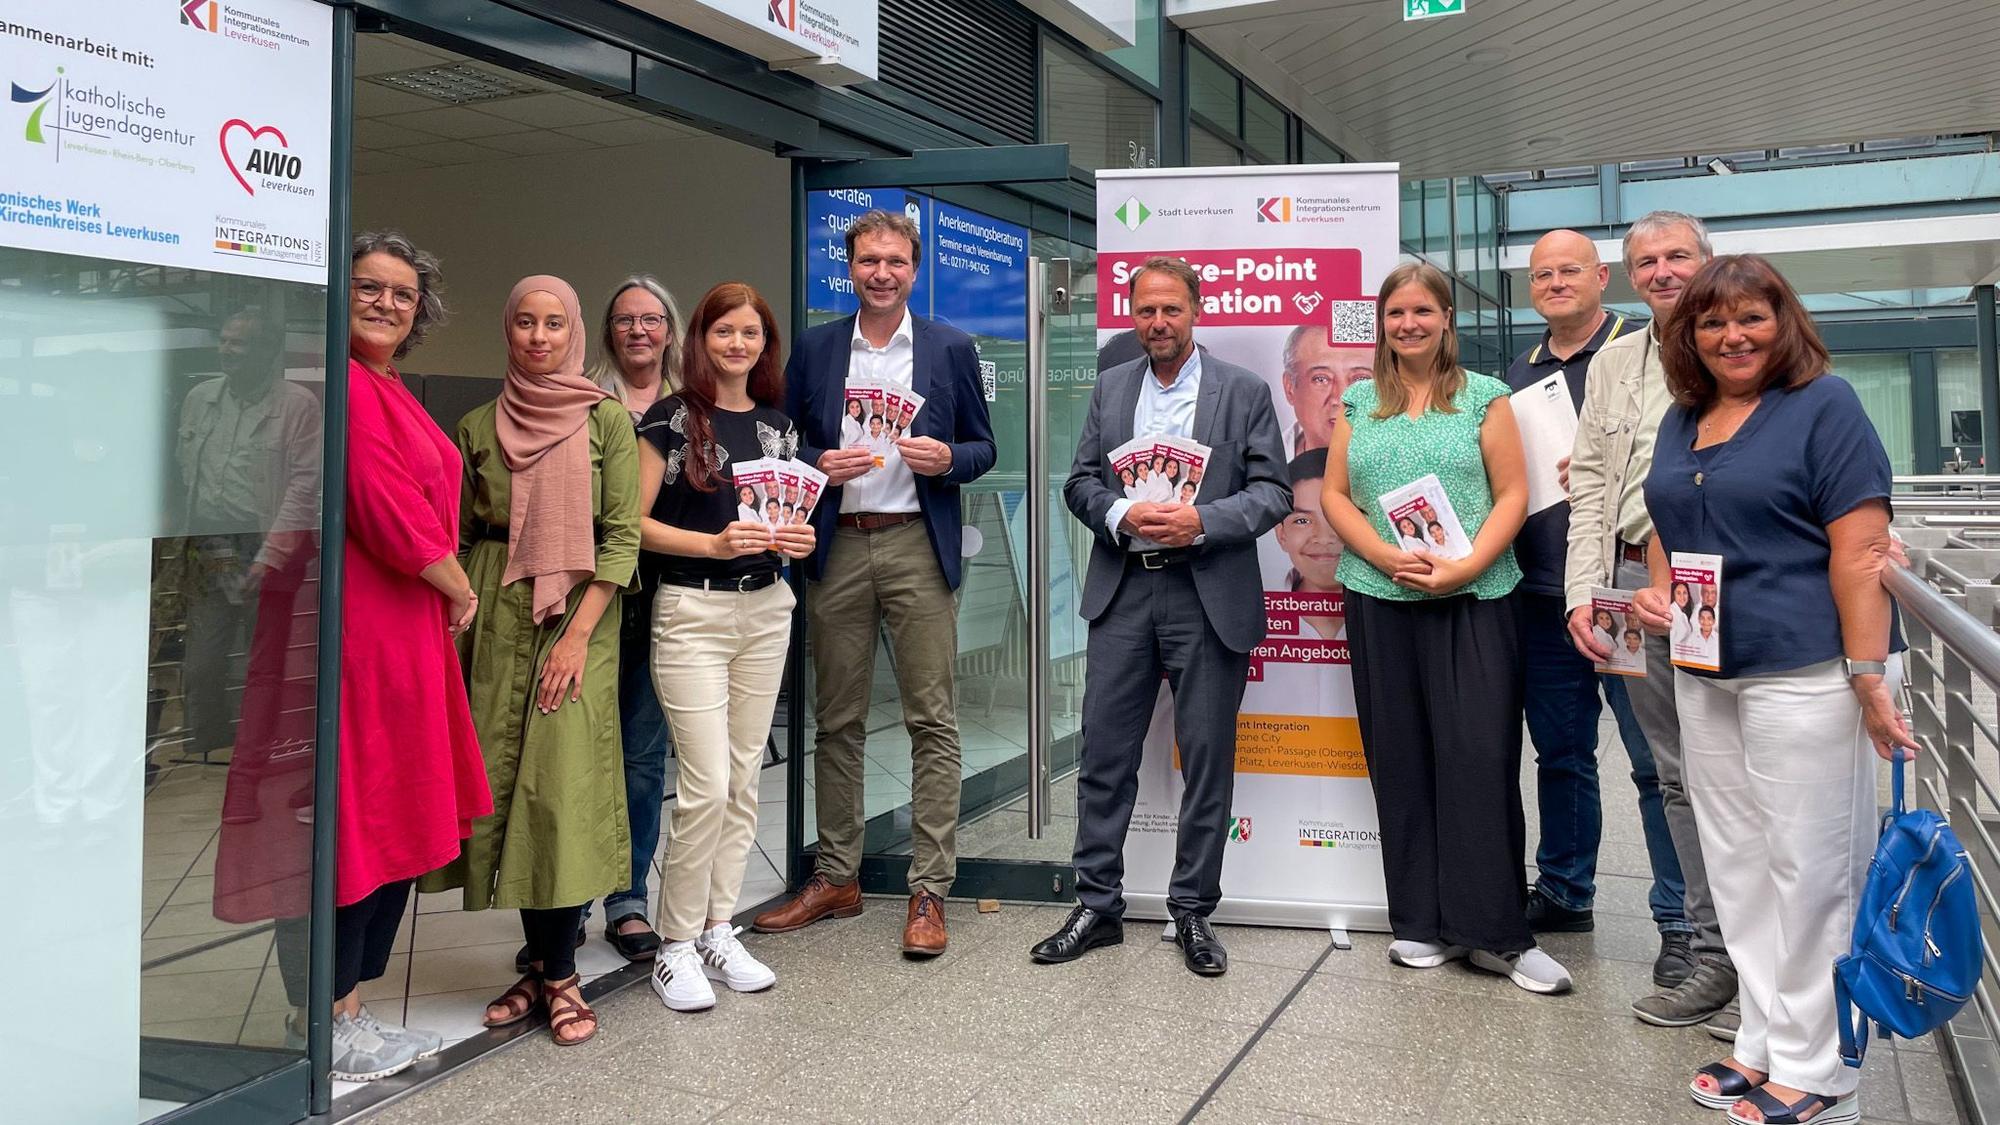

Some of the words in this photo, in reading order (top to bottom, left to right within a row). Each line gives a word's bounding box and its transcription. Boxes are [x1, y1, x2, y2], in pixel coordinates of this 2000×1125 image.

[224, 5, 280, 28] Kommunales
[224, 15, 310, 47] Integrationszentrum
[224, 27, 281, 51] Leverkusen
[800, 25, 839, 52] Leverkusen
[122, 51, 155, 69] mit:
[66, 79, 166, 119] katholische
[65, 105, 195, 146] jugendagentur
[245, 148, 302, 180] AWO
[261, 178, 315, 197] Leverkusen
[0, 191, 62, 212] onisches
[67, 199, 101, 218] Werk
[1158, 208, 1181, 217] Stadt
[1184, 207, 1234, 216] Leverkusen
[1296, 204, 1381, 213] Integrationszentrum
[215, 214, 266, 230] Kommunales
[1296, 215, 1345, 223] Leverkusen
[106, 221, 180, 245] Leverkusen
[215, 226, 310, 251] INTEGRATIONS
[938, 211, 1023, 252] Anerkennungsberatung
[260, 247, 308, 261] Management
[938, 235, 962, 251] Termine
[963, 243, 977, 256] nach
[976, 245, 1013, 267] Vereinbarung
[1112, 255, 1317, 285] Se-Point
[1253, 721, 1310, 732] Integration
[1261, 733, 1281, 744] City
[1339, 840, 1382, 850] Managemen
